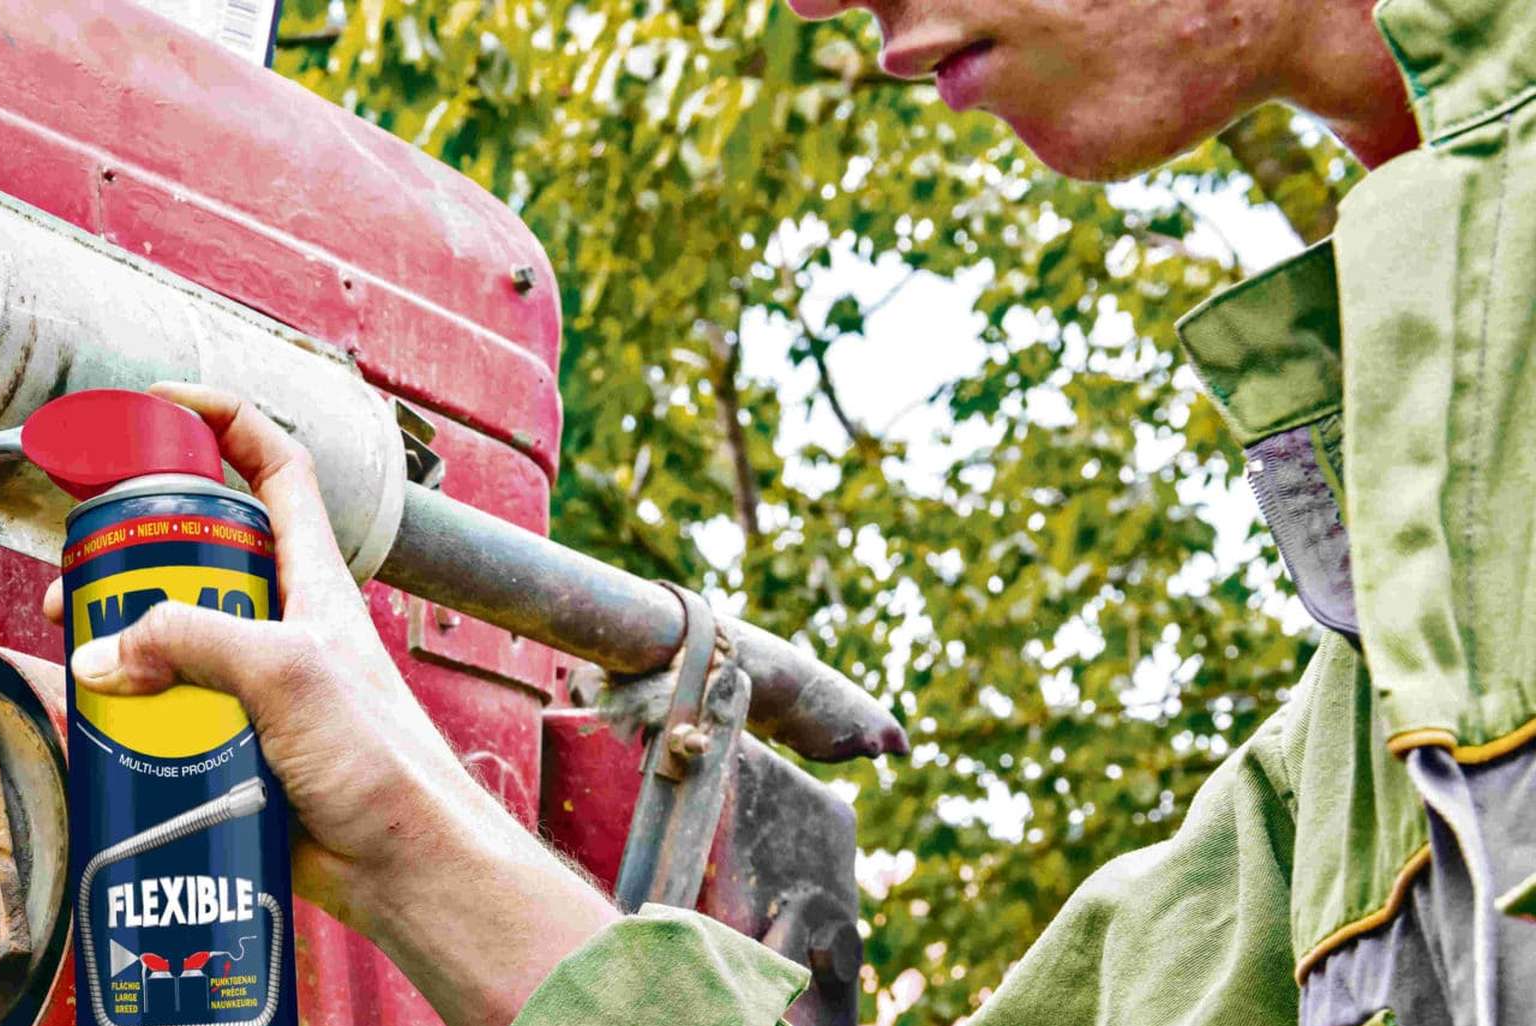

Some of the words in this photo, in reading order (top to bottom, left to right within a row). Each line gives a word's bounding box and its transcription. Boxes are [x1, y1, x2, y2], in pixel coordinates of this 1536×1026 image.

[84, 527, 126, 556] NOUVEAU
[137, 521, 169, 538] NIEUW
[181, 521, 201, 535] NEU
[212, 524, 255, 547] NOUVEAU
[119, 753, 179, 778] MULTI-USE
[182, 748, 235, 777] PRODUCT
[107, 875, 254, 928] FLEXIBLE
